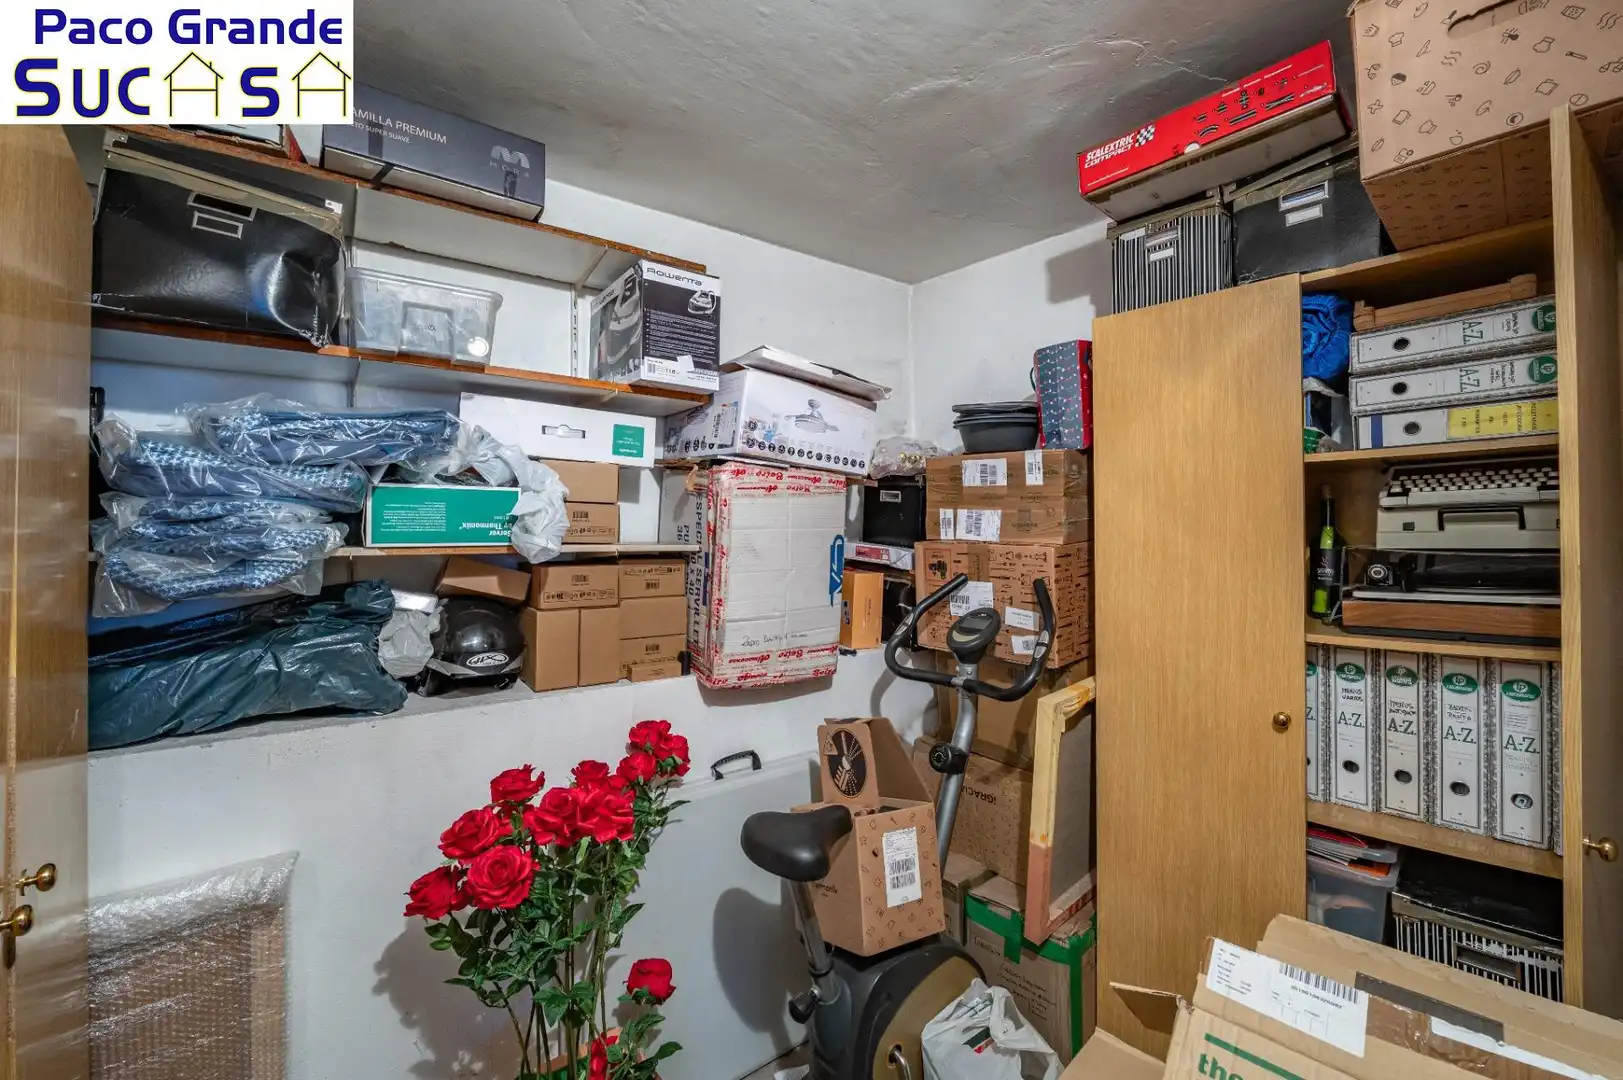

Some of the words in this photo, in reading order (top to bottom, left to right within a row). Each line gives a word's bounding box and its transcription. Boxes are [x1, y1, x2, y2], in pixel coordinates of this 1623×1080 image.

[352, 107, 393, 129] AMILLA
[395, 120, 448, 145] PREMIUM
[1085, 132, 1135, 162] SCALEXTRIC
